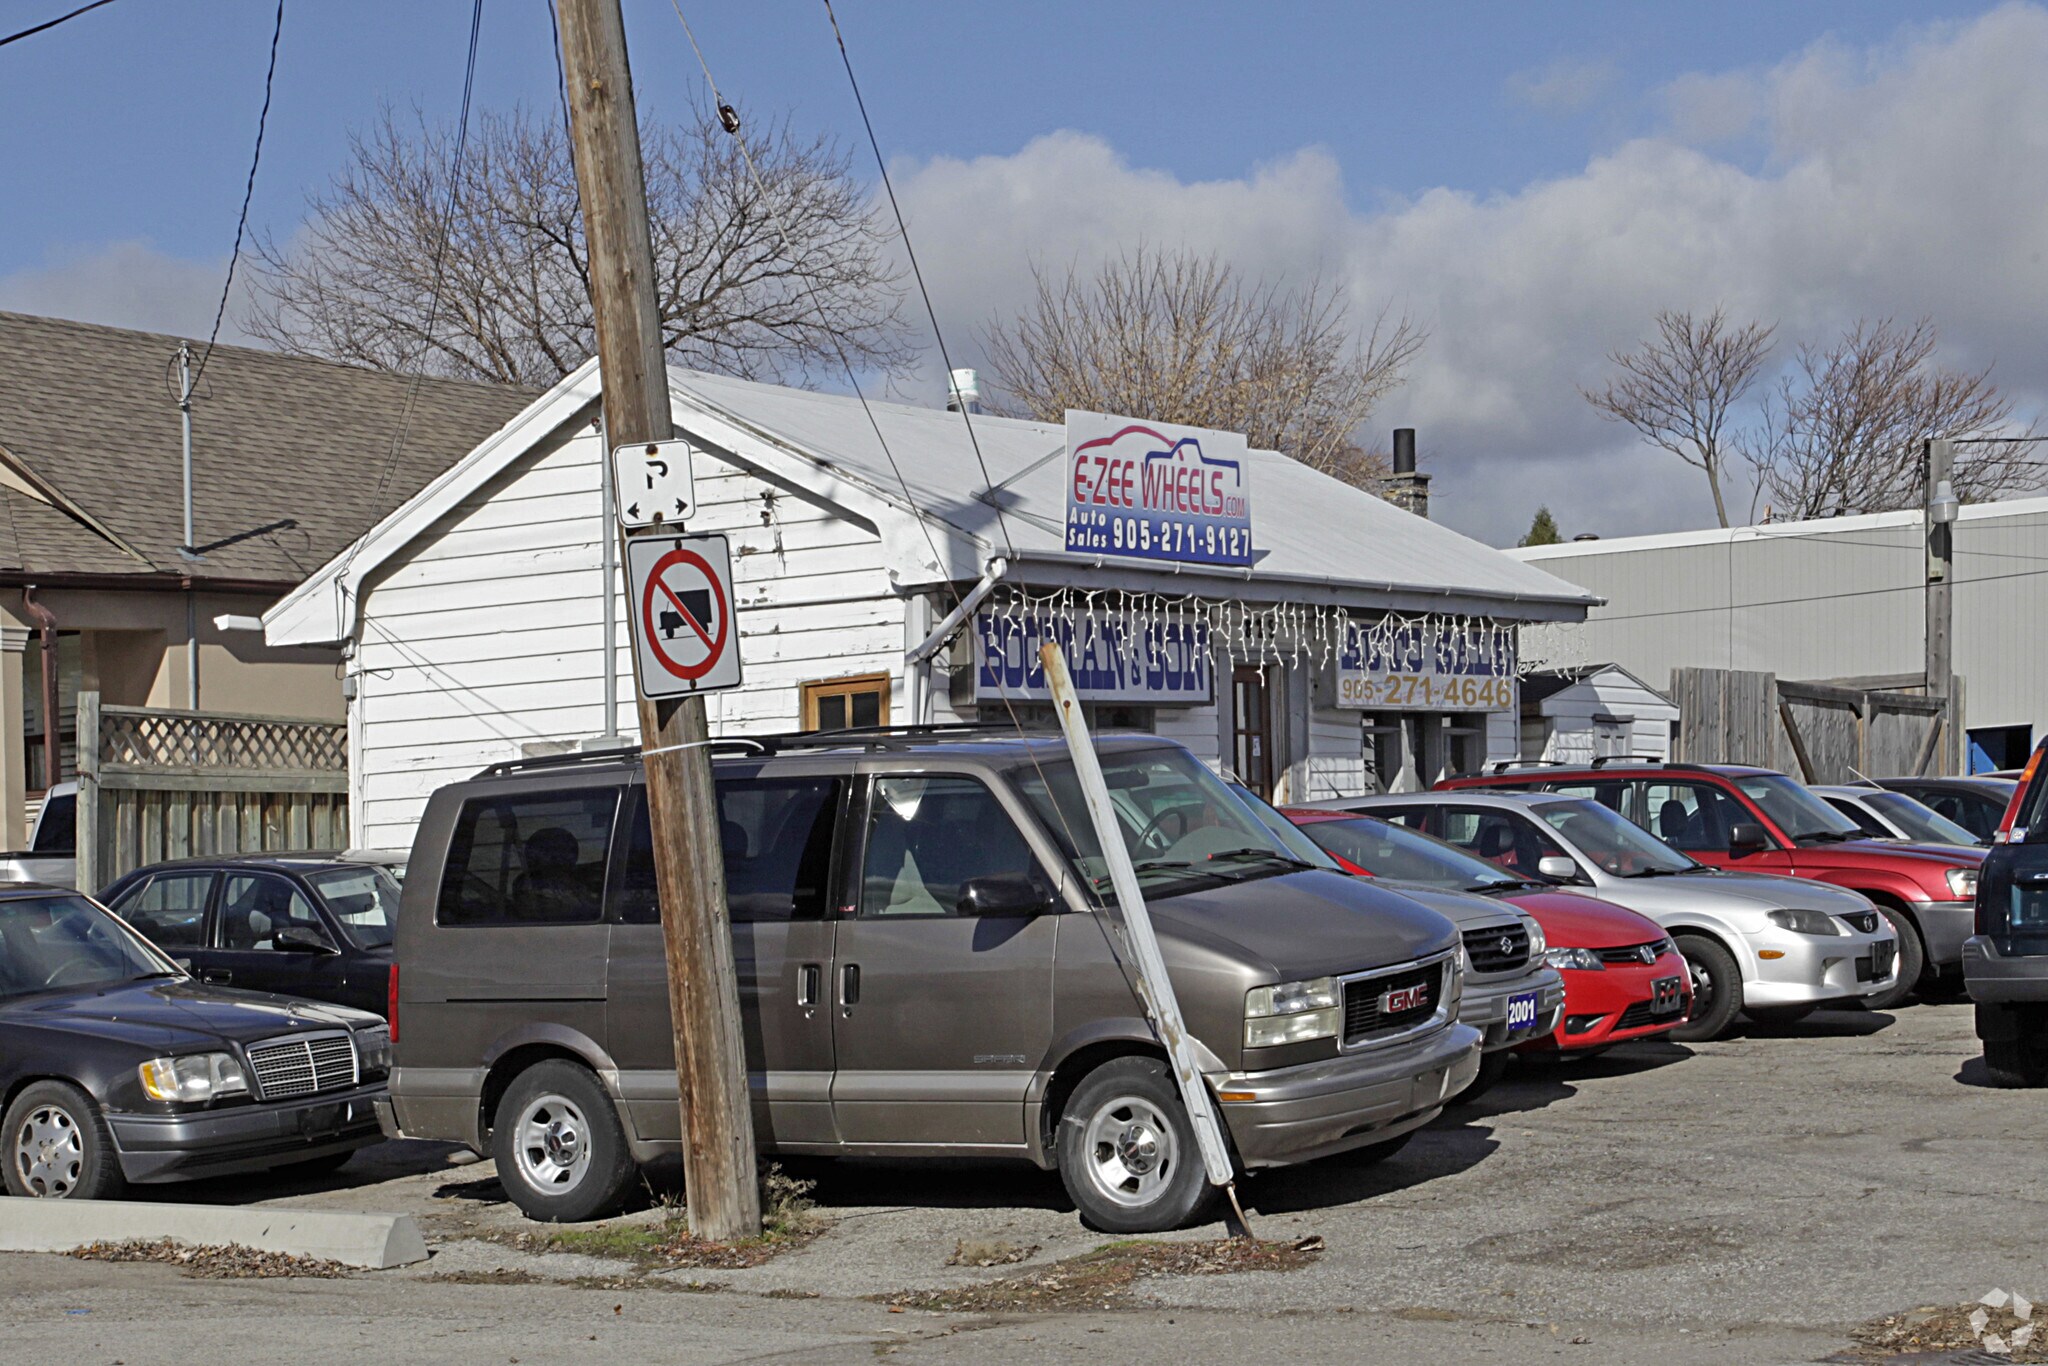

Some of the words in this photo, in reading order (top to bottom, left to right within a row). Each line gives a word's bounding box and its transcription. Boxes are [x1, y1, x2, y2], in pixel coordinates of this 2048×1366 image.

[1074, 455, 1134, 507] E-ZEE
[1069, 507, 1107, 527] Auto
[1068, 528, 1107, 548] Sales
[1113, 517, 1249, 557] 905-271-9127
[1145, 623, 1207, 691] SON
[1342, 624, 1423, 673] AUTO
[1343, 675, 1511, 708] 905-271-4646
[1387, 984, 1428, 1013] GMC
[1509, 999, 1535, 1025] 2001
